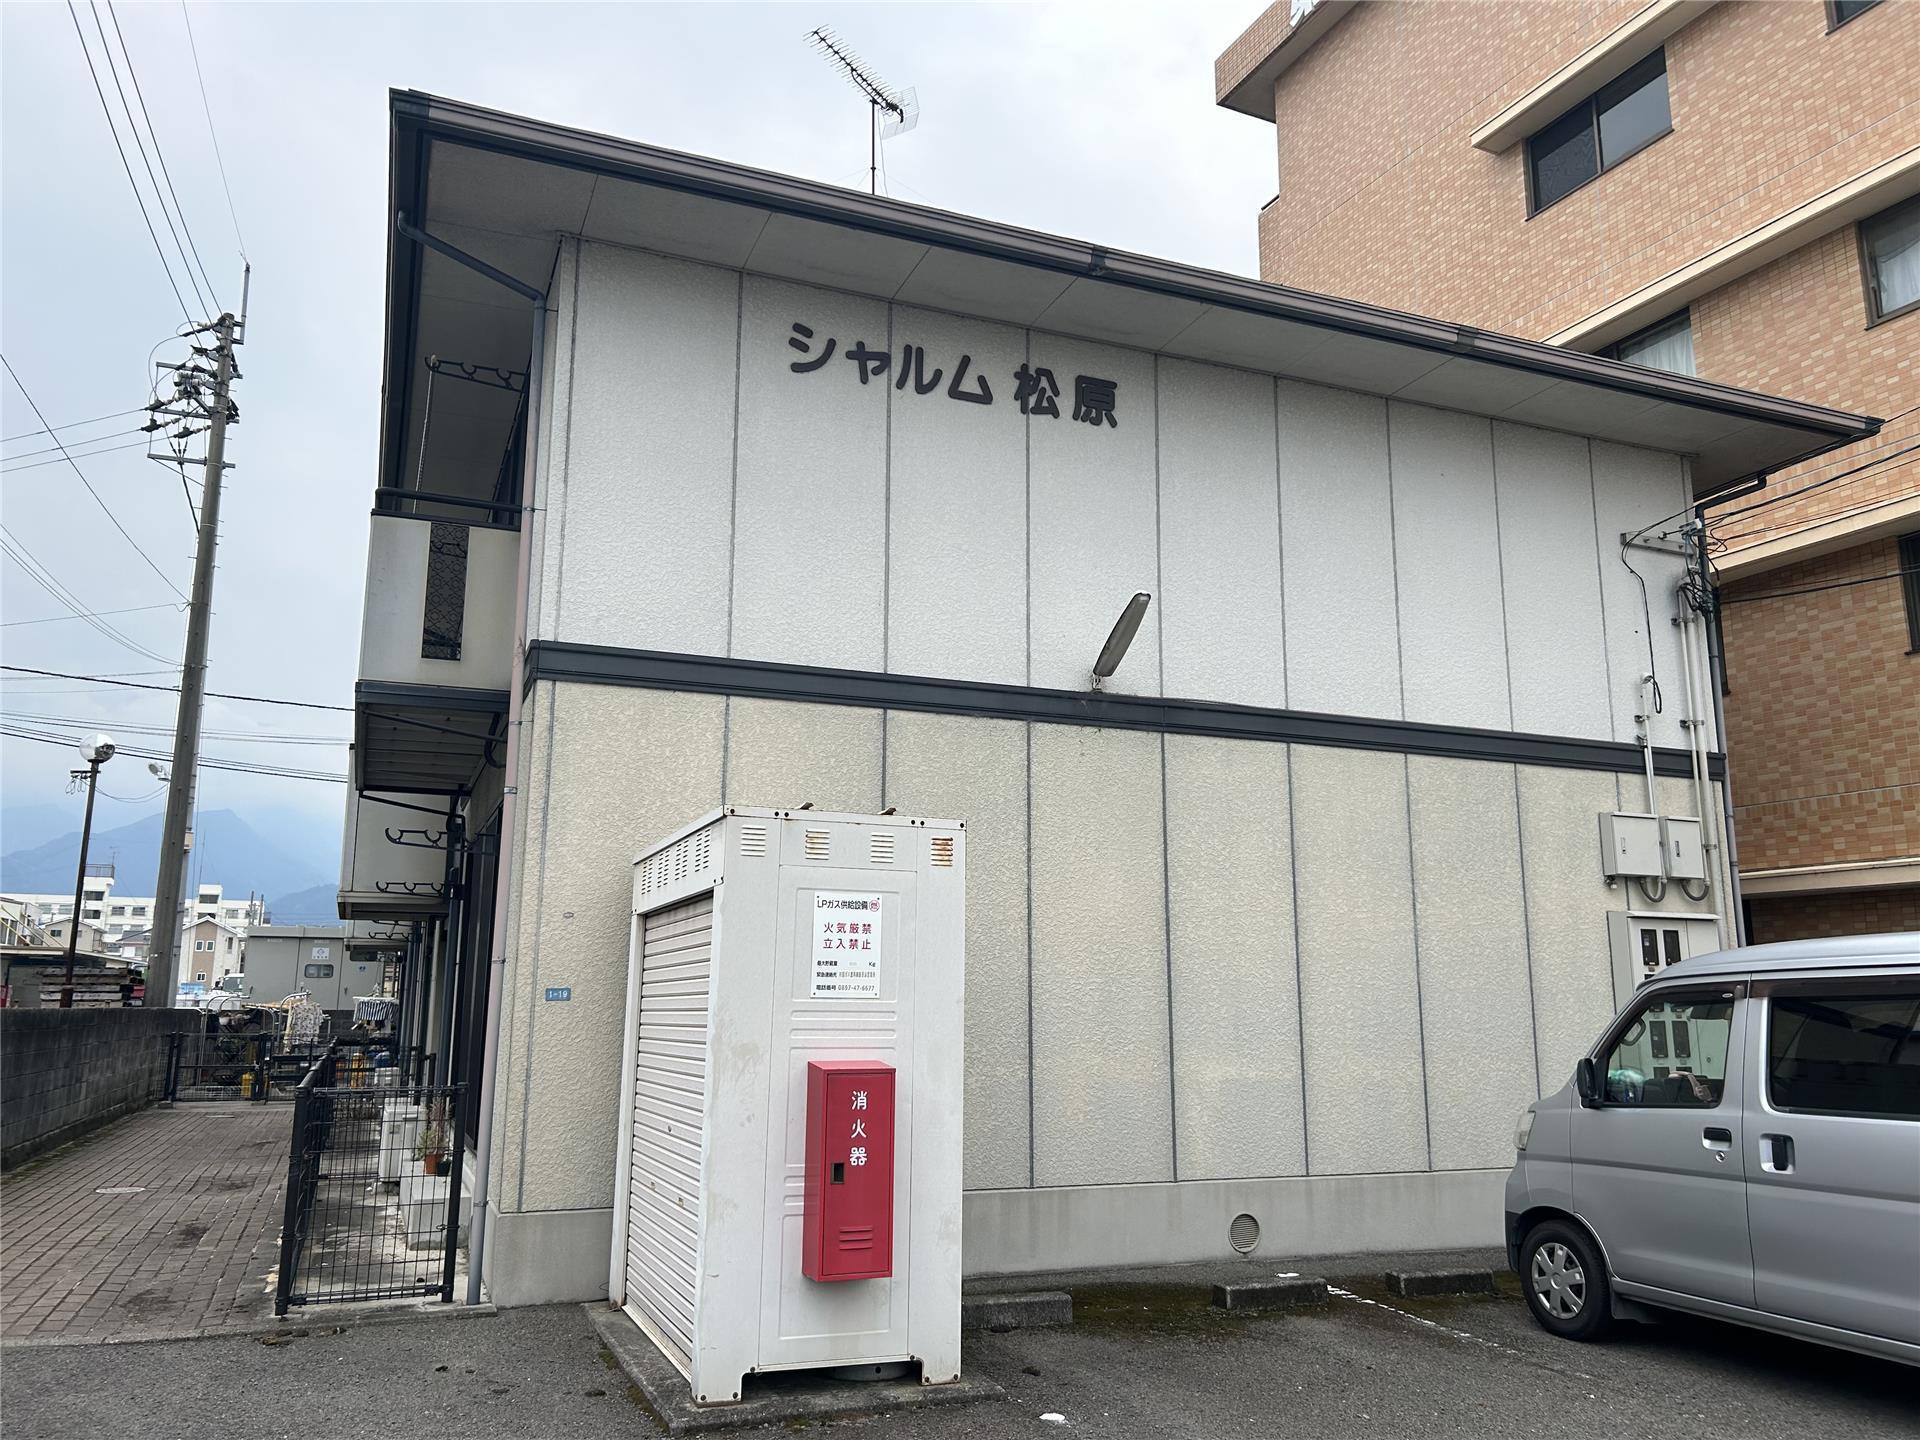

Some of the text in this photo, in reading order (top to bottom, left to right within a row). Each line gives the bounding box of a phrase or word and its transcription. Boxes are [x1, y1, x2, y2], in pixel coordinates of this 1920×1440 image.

[823, 922, 872, 935] 火気厳禁
[823, 938, 871, 950] 立入禁止
[850, 1091, 867, 1166] 消火器
